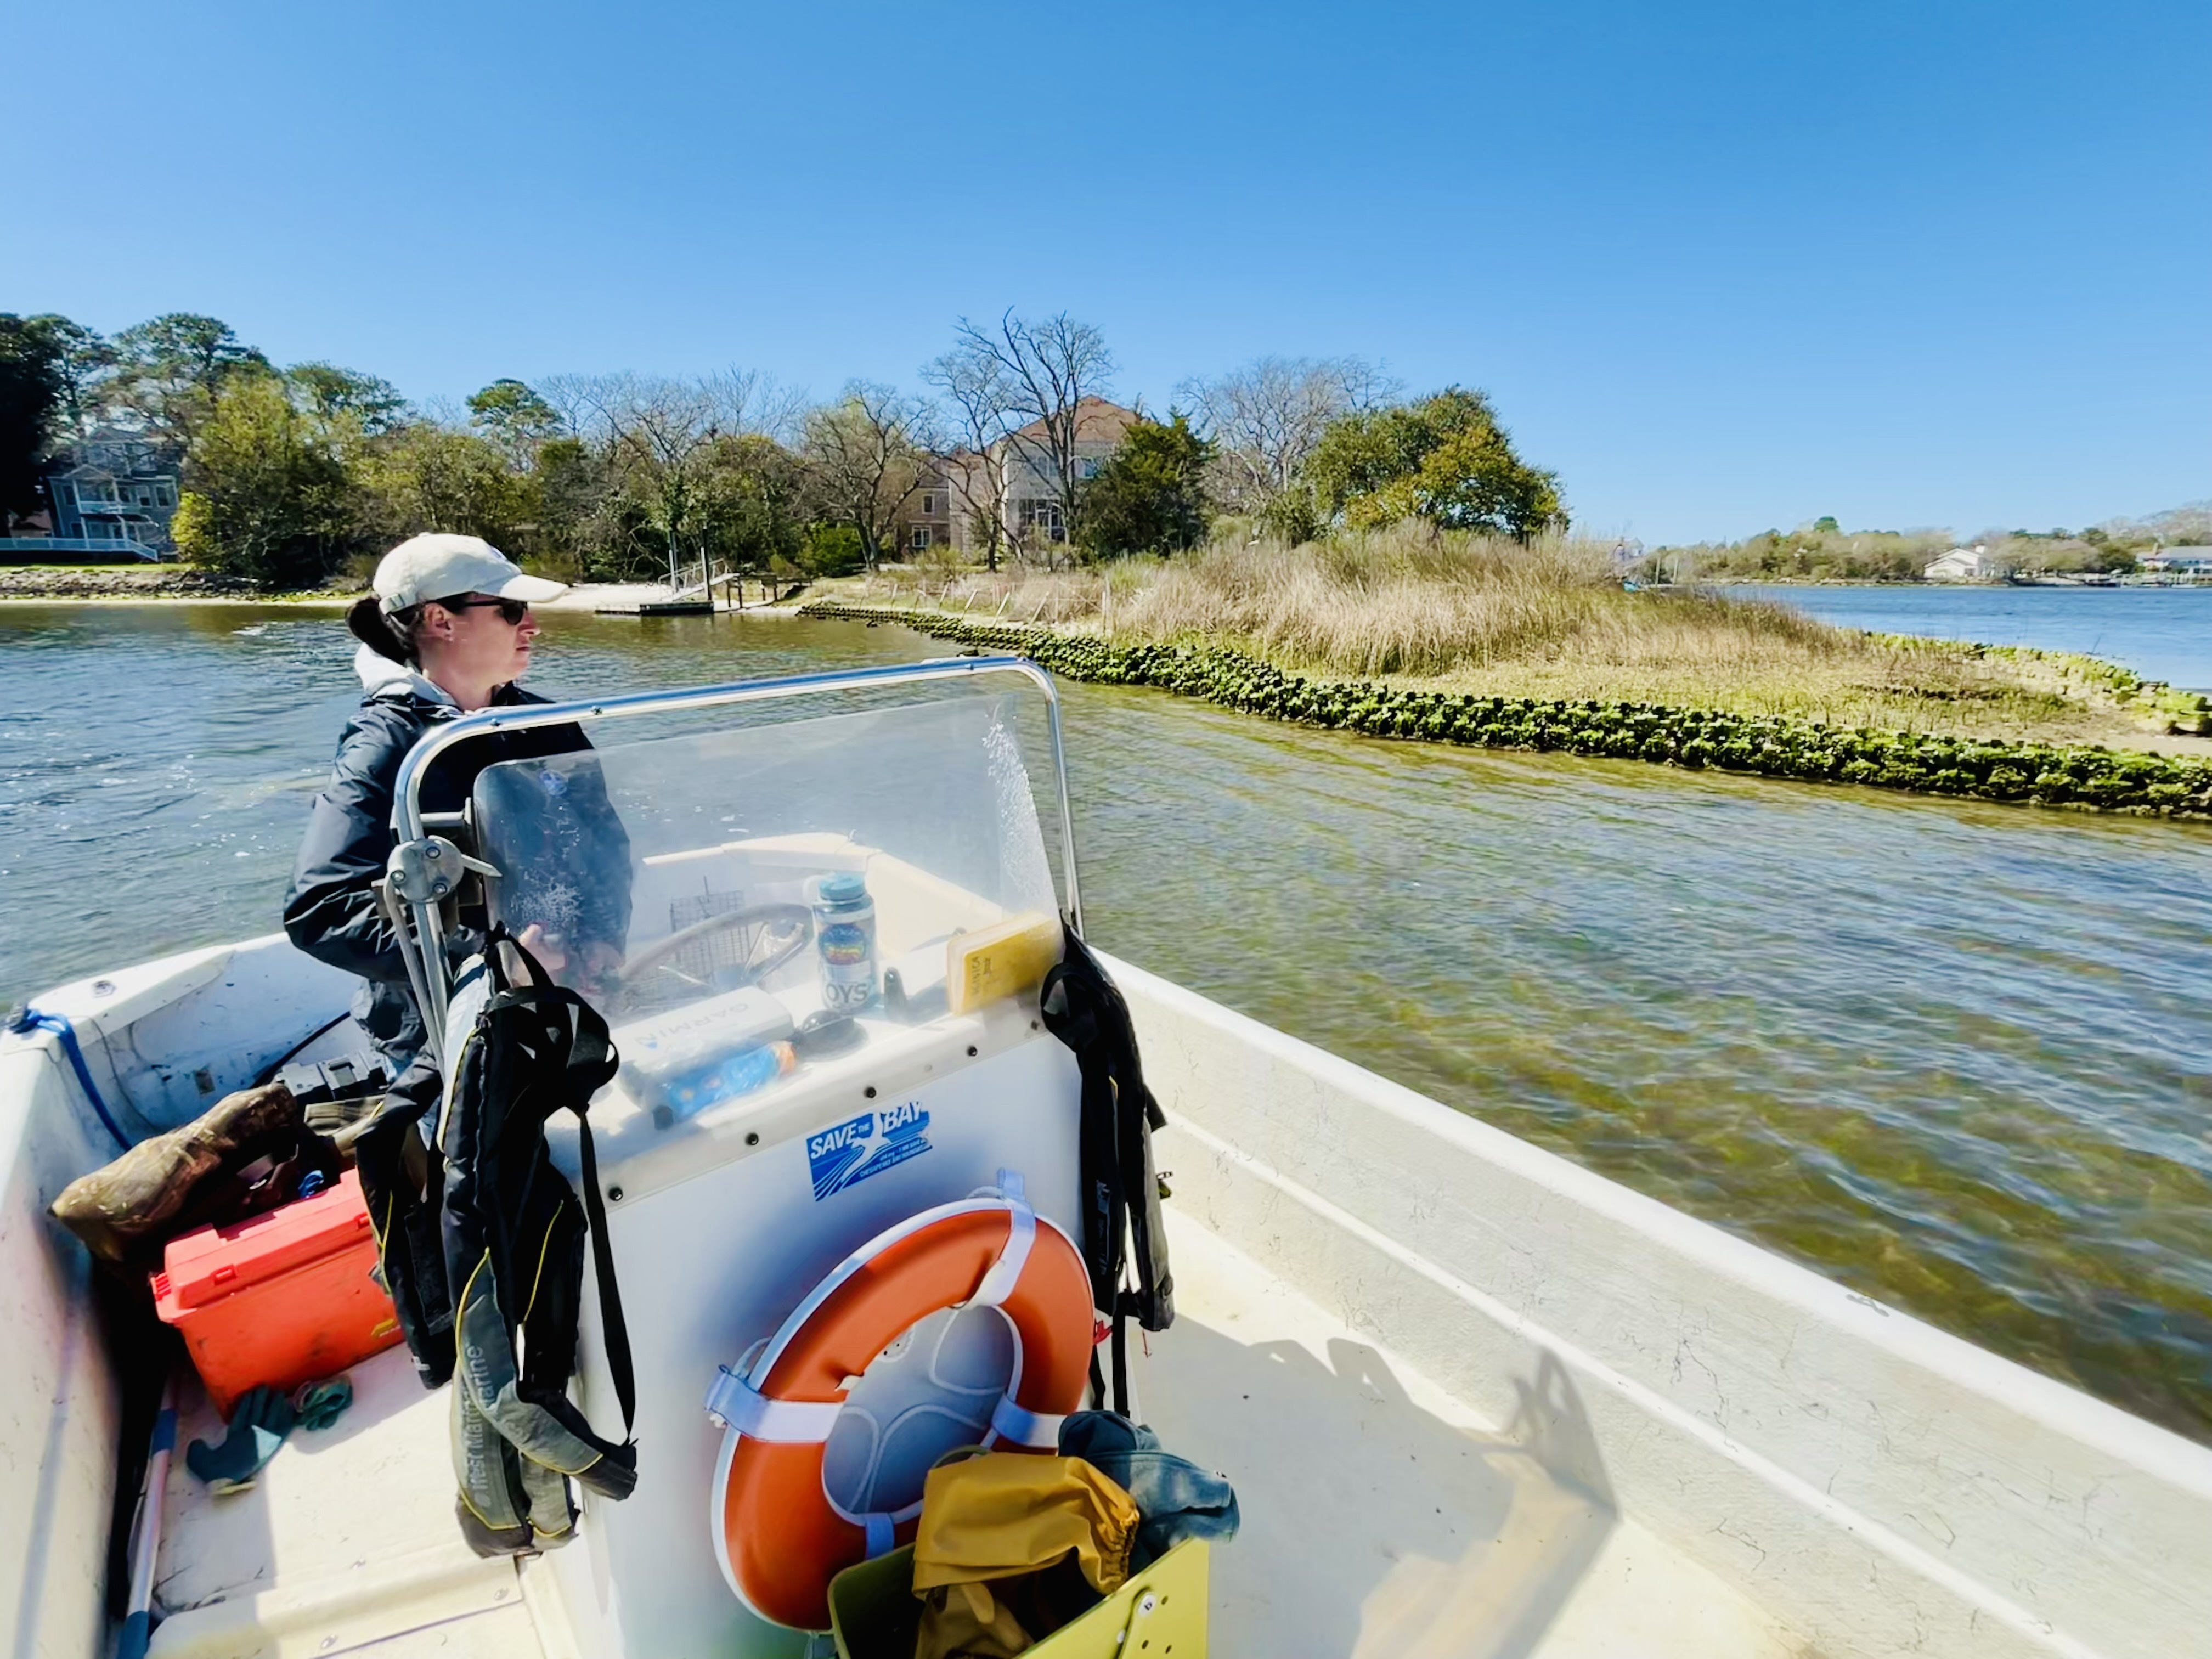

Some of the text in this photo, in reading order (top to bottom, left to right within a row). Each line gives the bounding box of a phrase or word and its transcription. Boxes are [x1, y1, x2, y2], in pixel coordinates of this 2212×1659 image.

[635, 1003, 749, 1045] GARMIN
[811, 1123, 856, 1159] SAVE
[883, 1101, 922, 1133] BAY
